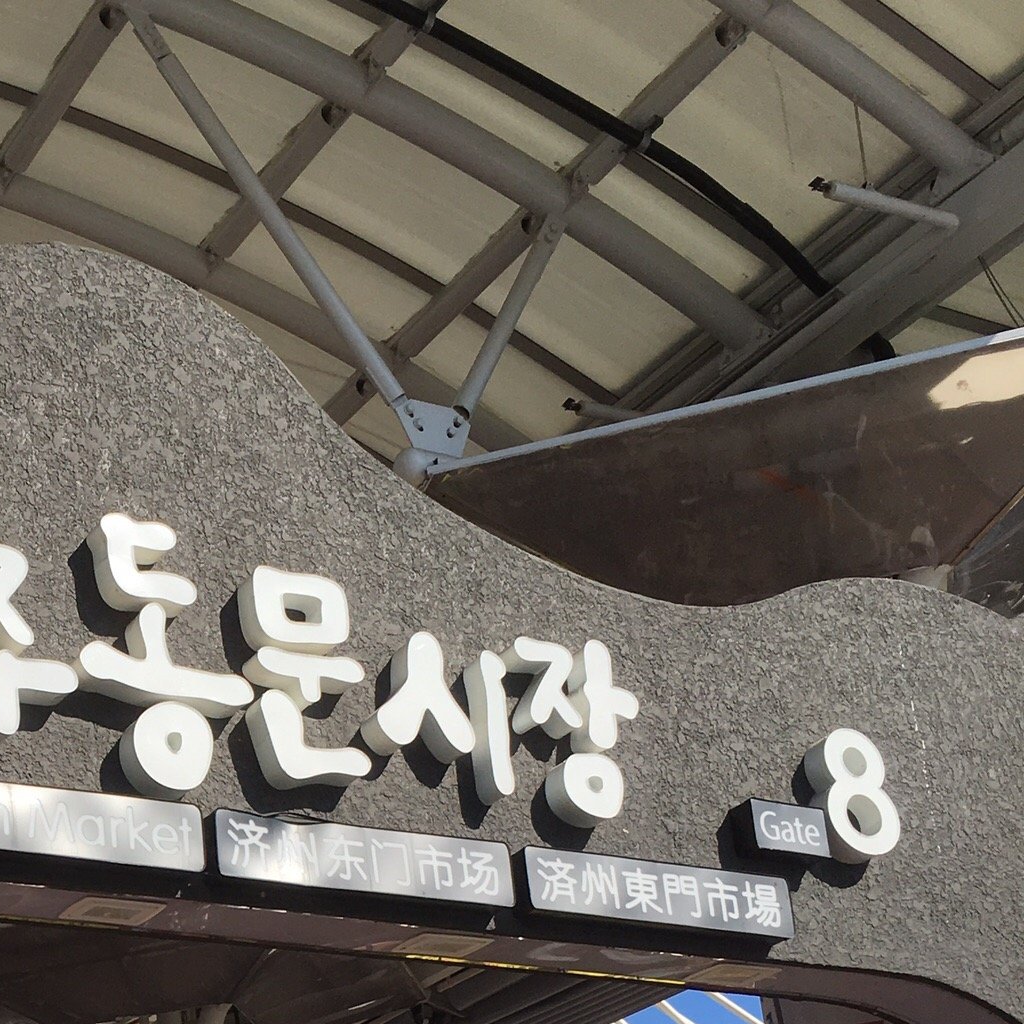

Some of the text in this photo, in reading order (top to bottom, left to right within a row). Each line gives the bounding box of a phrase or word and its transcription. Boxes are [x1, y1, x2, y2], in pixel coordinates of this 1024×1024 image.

[28, 797, 192, 858] Market
[758, 727, 901, 860] Gate 8
[227, 817, 500, 898] 济州东门市场
